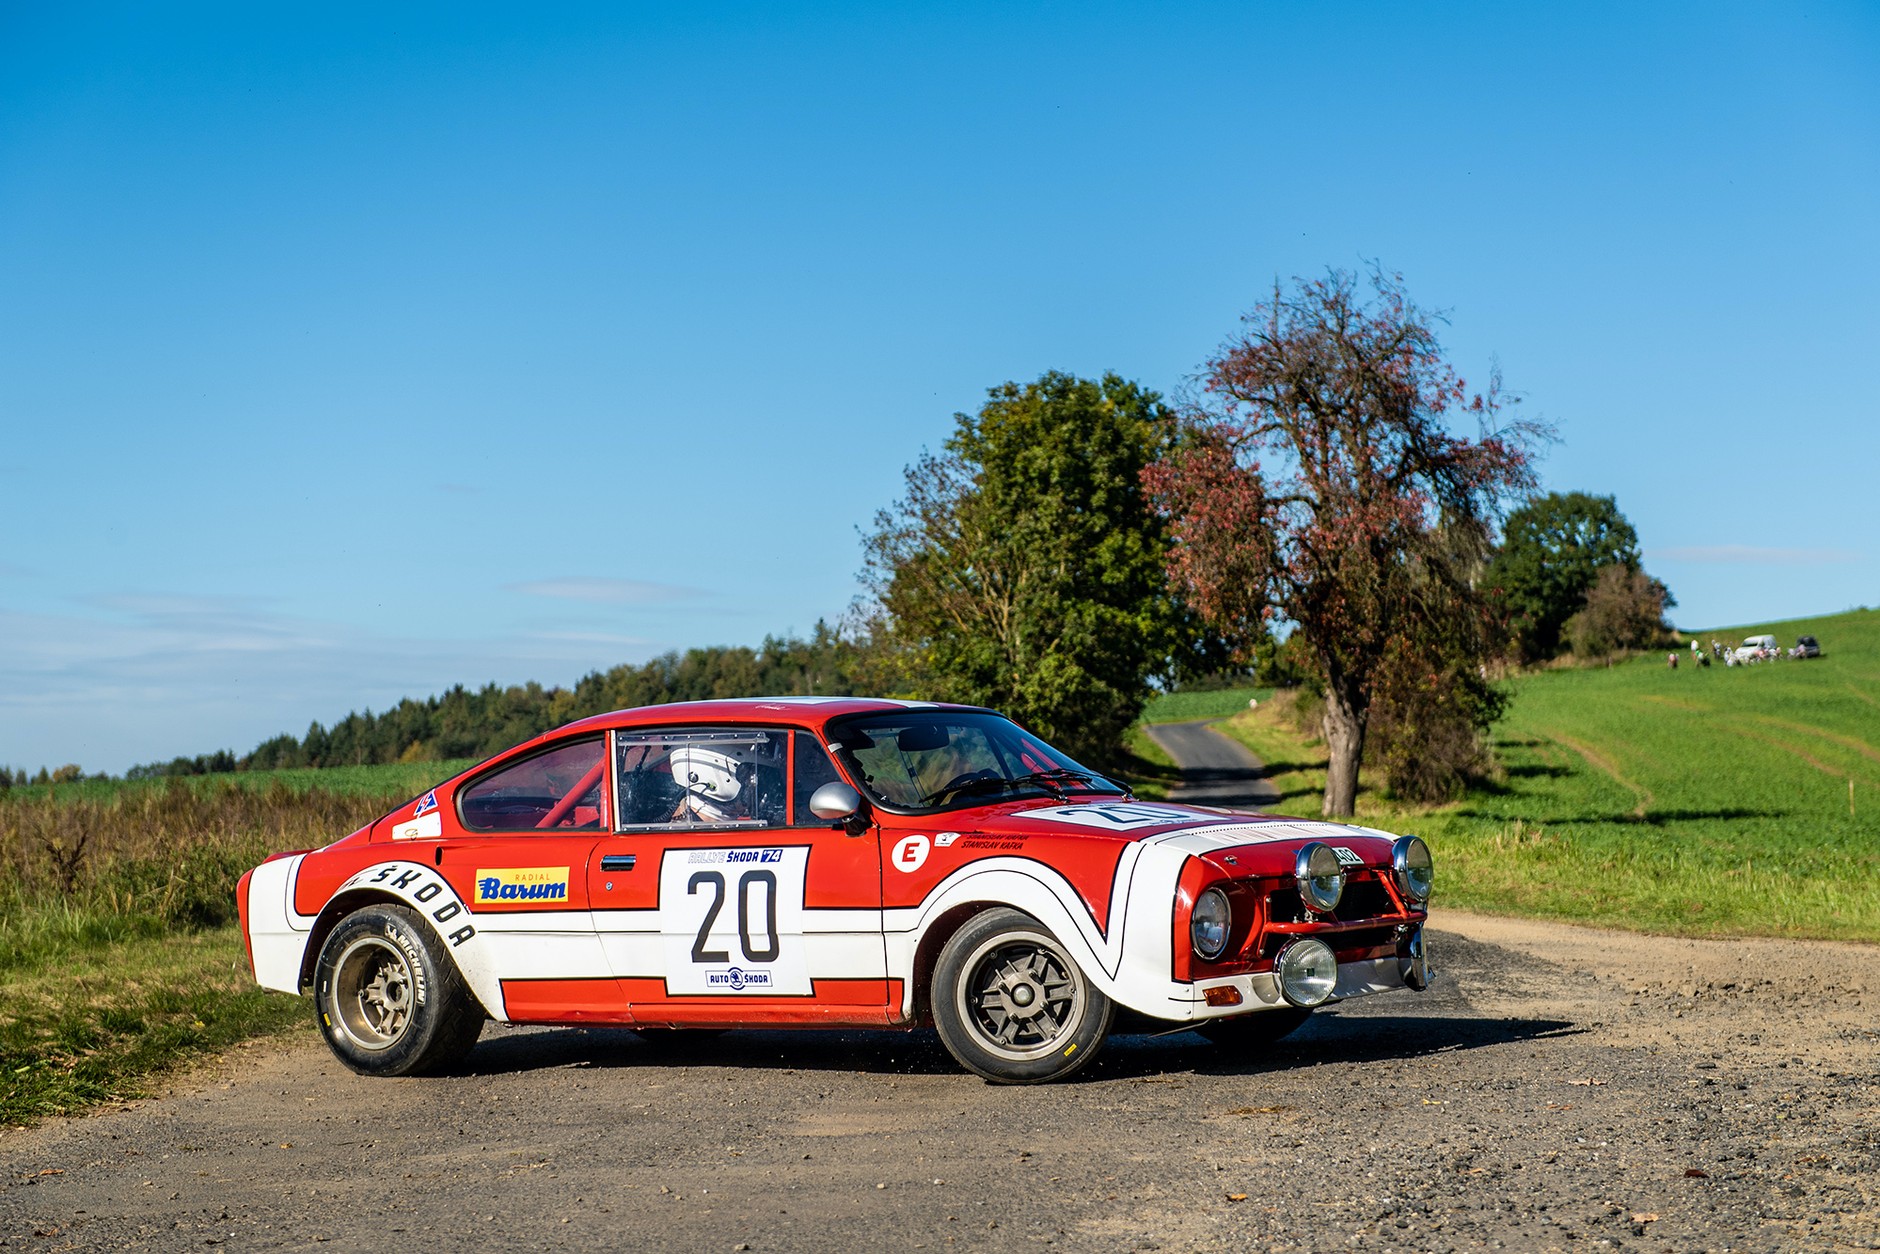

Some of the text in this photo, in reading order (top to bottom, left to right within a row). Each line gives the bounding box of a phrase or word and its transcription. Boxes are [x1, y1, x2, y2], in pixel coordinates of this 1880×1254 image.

[1056, 802, 1190, 823] 20
[902, 843, 920, 862] E
[961, 841, 1000, 849] STANISLAV
[999, 841, 1024, 850] KAFKA
[688, 851, 727, 864] RALLYE
[726, 850, 759, 863] ŠKODA
[515, 873, 551, 882] RADIAL
[478, 877, 567, 900] Barum
[370, 864, 476, 947] ŠKODA
[687, 870, 780, 963] 20
[397, 934, 425, 1005] MICHELIN
[710, 973, 769, 984] AUTO ŠKODA
